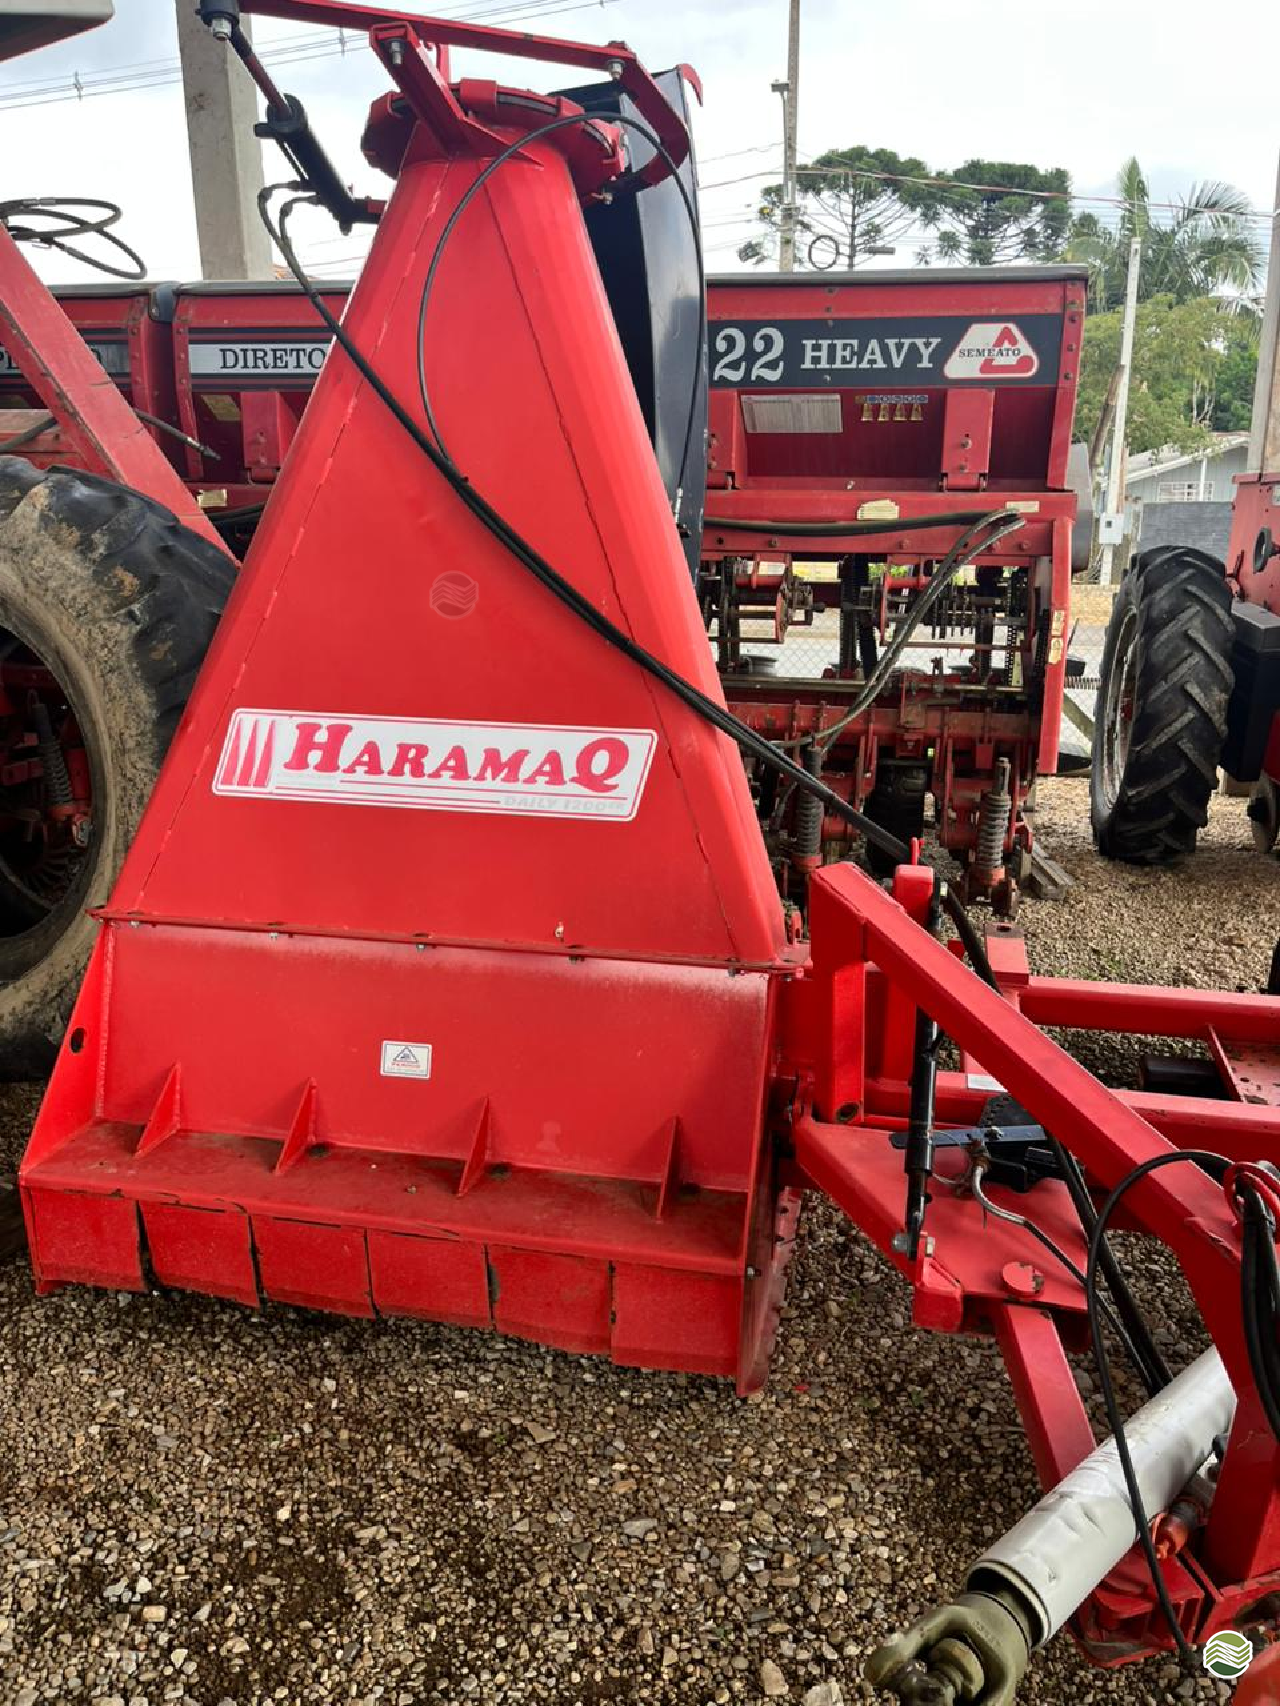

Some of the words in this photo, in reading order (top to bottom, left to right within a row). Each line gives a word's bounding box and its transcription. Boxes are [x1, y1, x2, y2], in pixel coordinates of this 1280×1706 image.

[219, 347, 326, 370] DIRETO
[800, 337, 942, 370] HEAVY
[959, 347, 1022, 358] SEMEATO
[283, 721, 630, 793] HARAMAQ
[503, 795, 558, 810] DAILY
